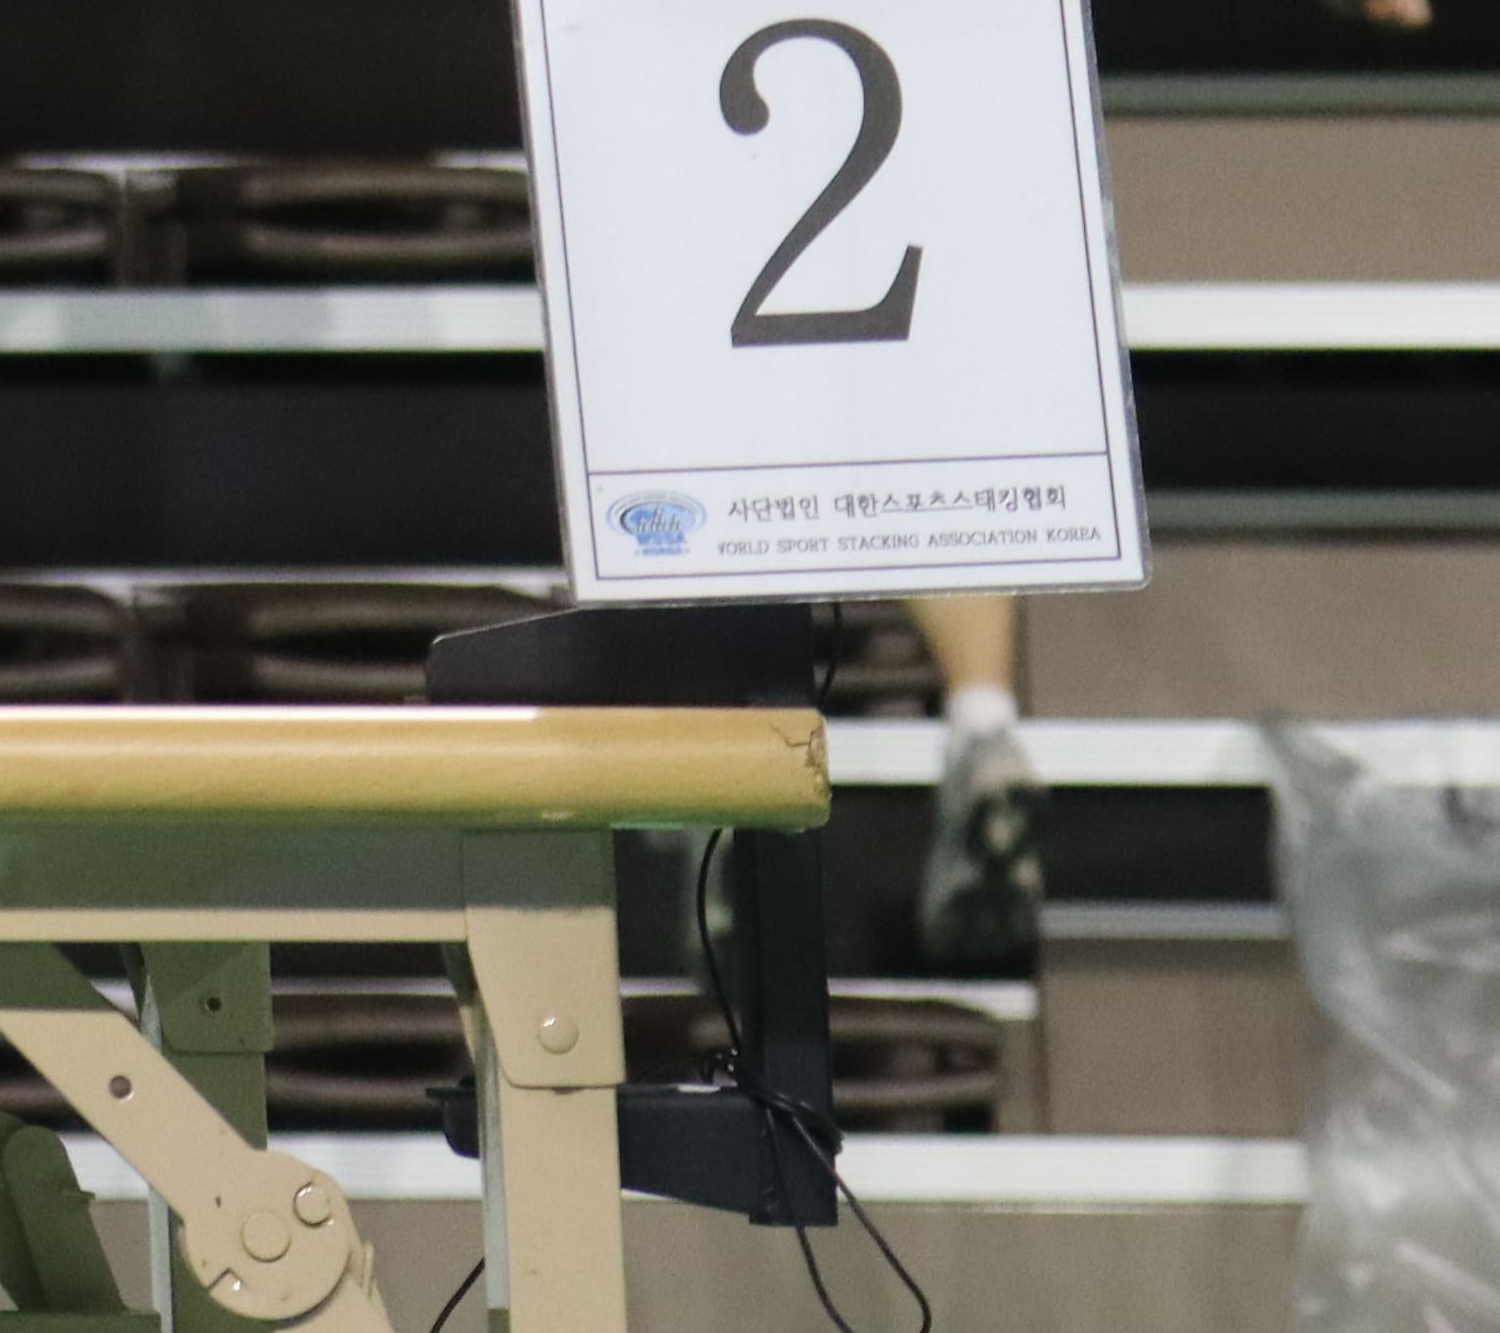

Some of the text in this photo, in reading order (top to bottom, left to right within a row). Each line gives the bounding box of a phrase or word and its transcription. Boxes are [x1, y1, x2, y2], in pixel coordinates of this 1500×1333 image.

[719, 18, 924, 348] 2
[727, 496, 821, 523] 사단법인
[833, 485, 1067, 518] 대한스포츠스태킹협회
[717, 526, 1101, 555] WORLD SPORT STACKING ASSOCIATION KOREA
